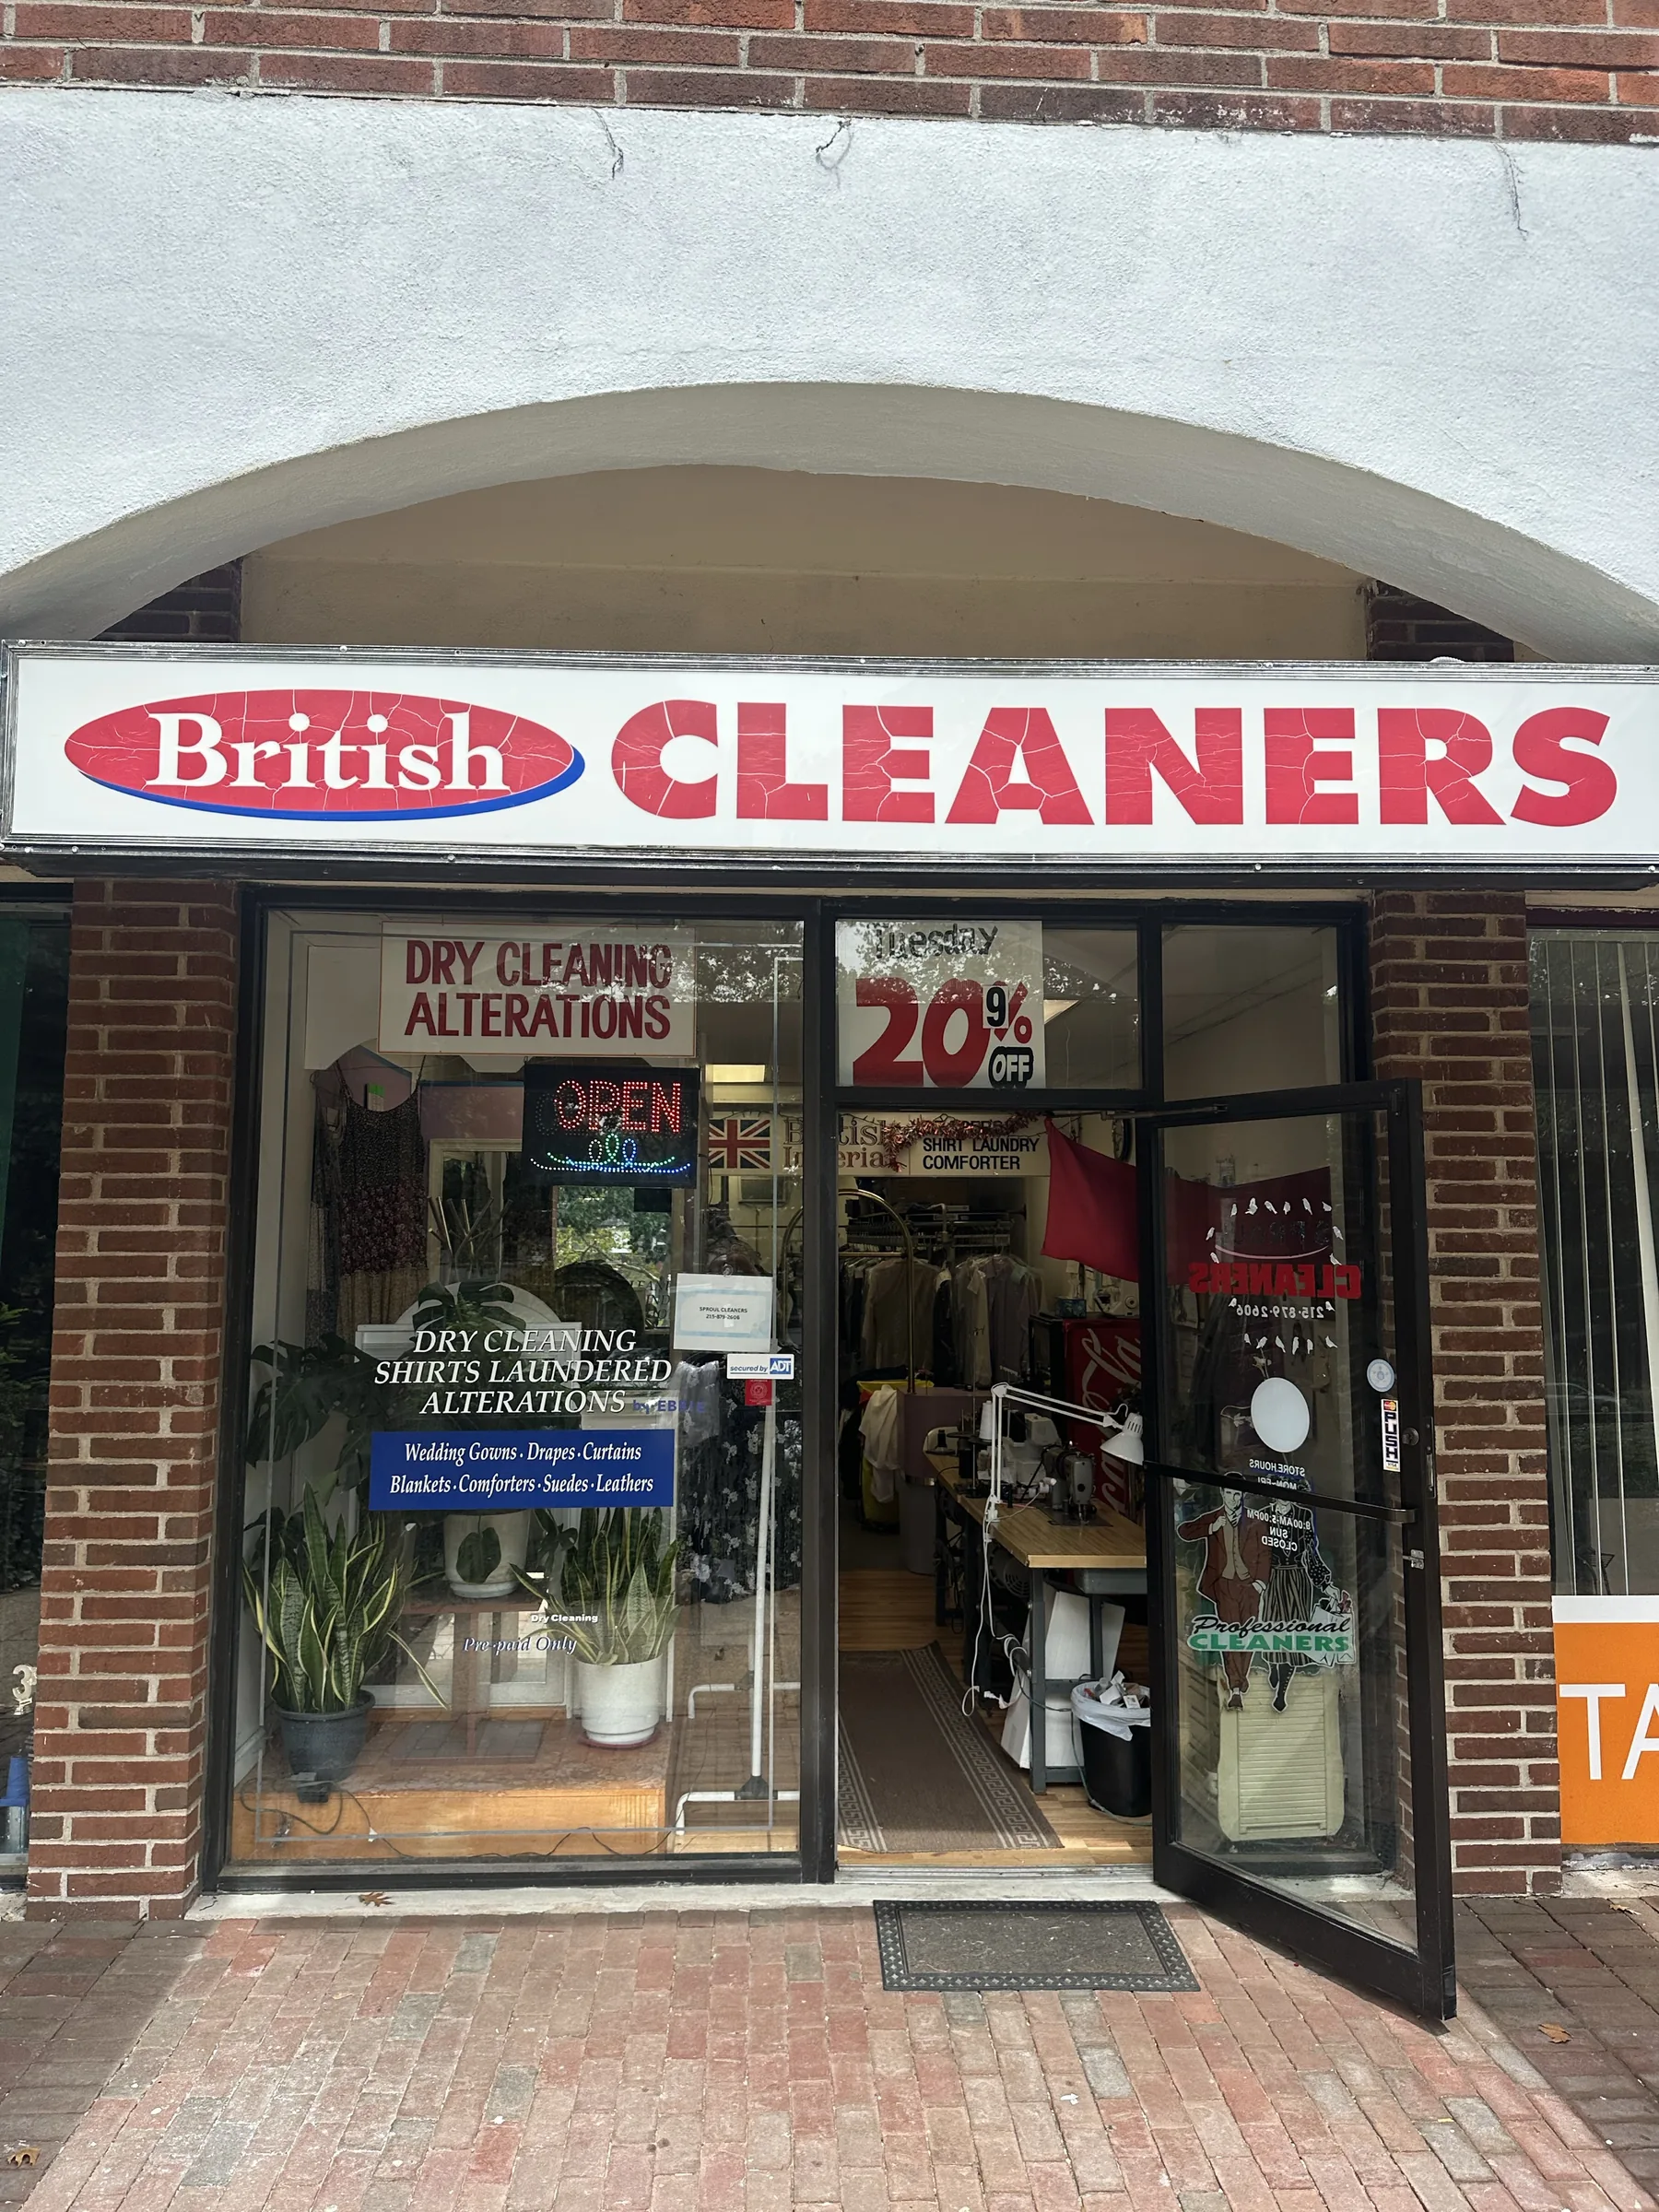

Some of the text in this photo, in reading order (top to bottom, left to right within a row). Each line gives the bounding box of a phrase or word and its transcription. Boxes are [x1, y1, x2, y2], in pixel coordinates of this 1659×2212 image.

[145, 700, 1618, 827] British CLEANERS
[872, 923, 999, 959] Tuesday
[406, 939, 673, 989] DRY CLEANING
[404, 991, 671, 1040] ALTERATIONS
[991, 1052, 1031, 1084] OFF
[553, 1079, 682, 1134] OPEN
[923, 1136, 1041, 1152] SHIRT LAUNDRY
[923, 1155, 1020, 1171] COMFORTER
[413, 1329, 637, 1354] DRY CLEANING
[374, 1359, 673, 1384] SHIRTS LAUNDERED
[770, 1361, 792, 1372] ADT
[419, 1389, 626, 1415] ALTERATIONS
[1383, 1411, 1398, 1459] PUSH
[405, 1441, 641, 1467] Wedding Gowns Drapes Curtains
[389, 1473, 654, 1499] Blankets Comforters Suedes Leathers
[531, 1613, 599, 1624] Dry Cleaning
[1194, 1616, 1351, 1638] Professional
[463, 1636, 577, 1656] Pre-paid Only
[1189, 1633, 1350, 1653] CLEANERS
